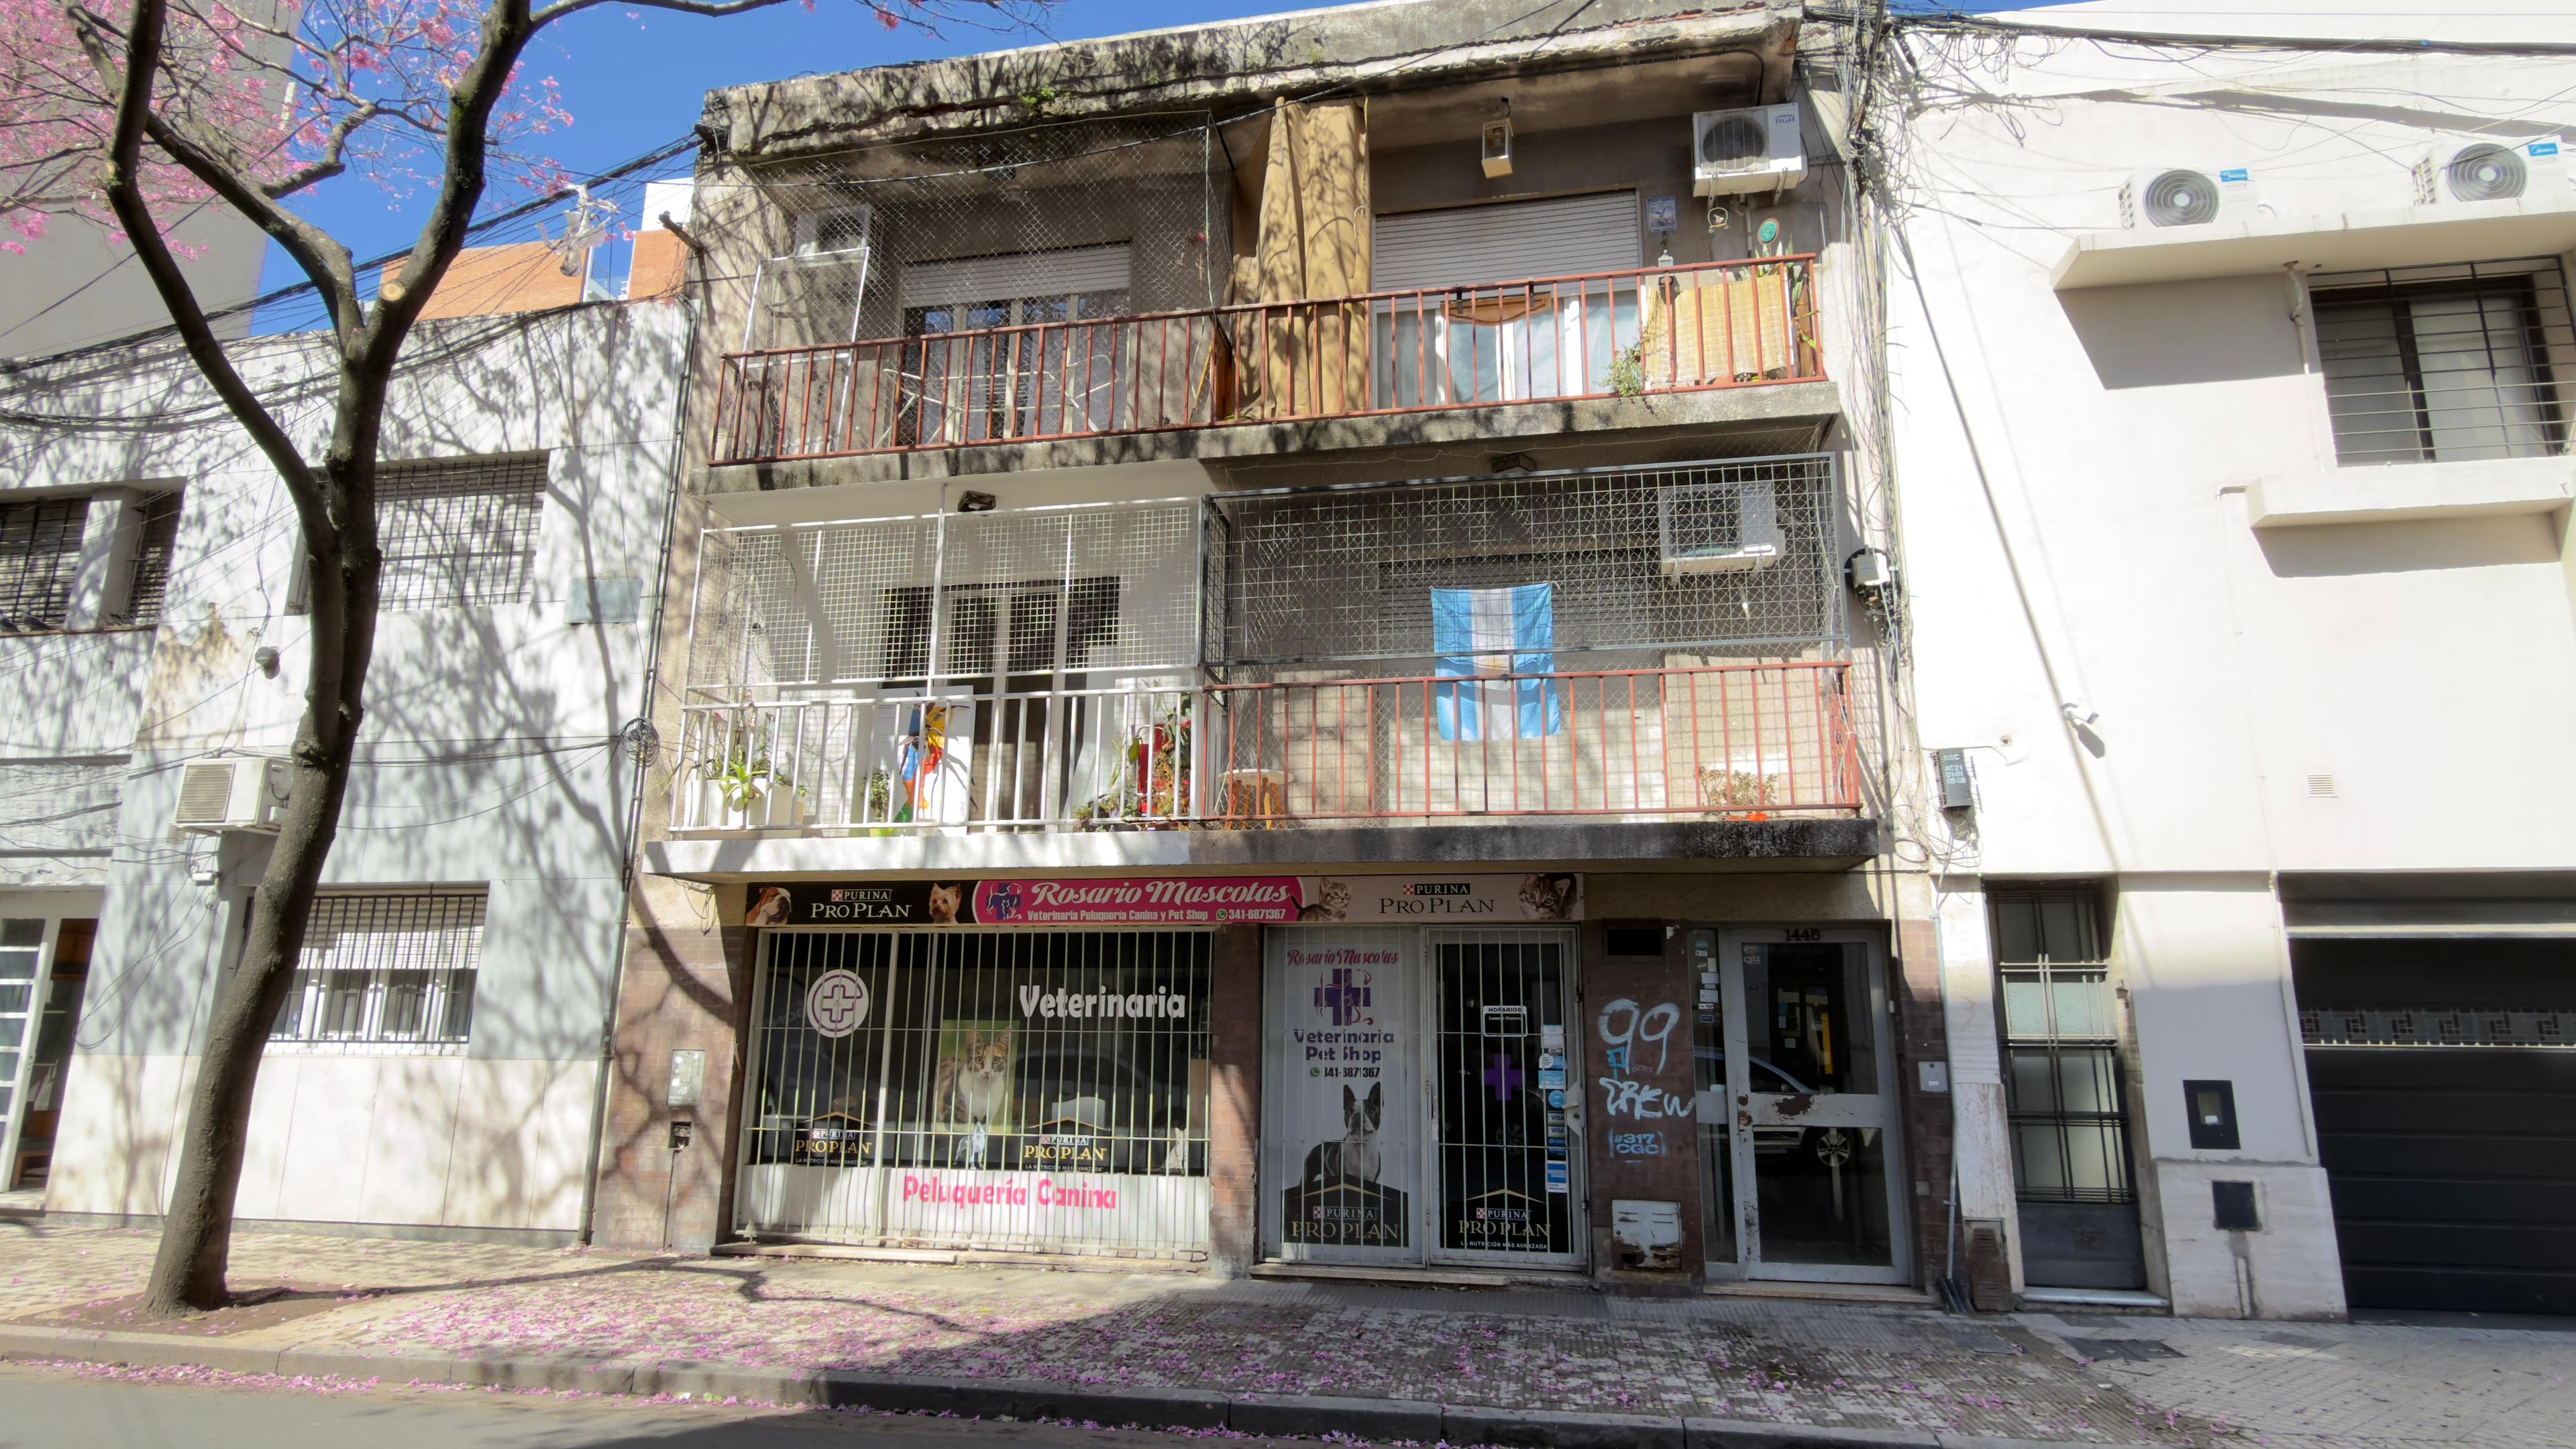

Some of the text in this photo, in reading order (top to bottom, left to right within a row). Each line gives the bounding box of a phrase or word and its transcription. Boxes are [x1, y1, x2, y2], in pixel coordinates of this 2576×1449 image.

[844, 891, 888, 900] PURINA
[1031, 881, 1290, 906] Rosario Mascotas
[1416, 885, 1468, 894] PURINA
[810, 902, 911, 918] PRO PLAN
[1379, 898, 1495, 914] PRO PLAN
[1027, 910, 1078, 920] Veterinaria
[1129, 910, 1158, 920] Canina
[1161, 911, 1168, 922] y
[1168, 910, 1183, 920] Pet
[1186, 909, 1208, 922] Shop
[1228, 908, 1286, 920] 341-6871367
[1019, 985, 1186, 1018] Veterinaria
[1293, 1029, 1395, 1043] Veterinaria
[1598, 998, 1680, 1075] 99
[1305, 1046, 1336, 1061] Pet
[1614, 1133, 1655, 1144] #317
[795, 1140, 870, 1154] PRO PLAN
[1024, 1145, 1106, 1161] PRO PLAN
[902, 1176, 1117, 1209] Peluquería Canina
[1327, 1209, 1374, 1218] PURINA
[1488, 1210, 1527, 1219] PURINA
[1291, 1221, 1399, 1240] PRO PLAN
[1458, 1220, 1551, 1237] PRO PLAN
